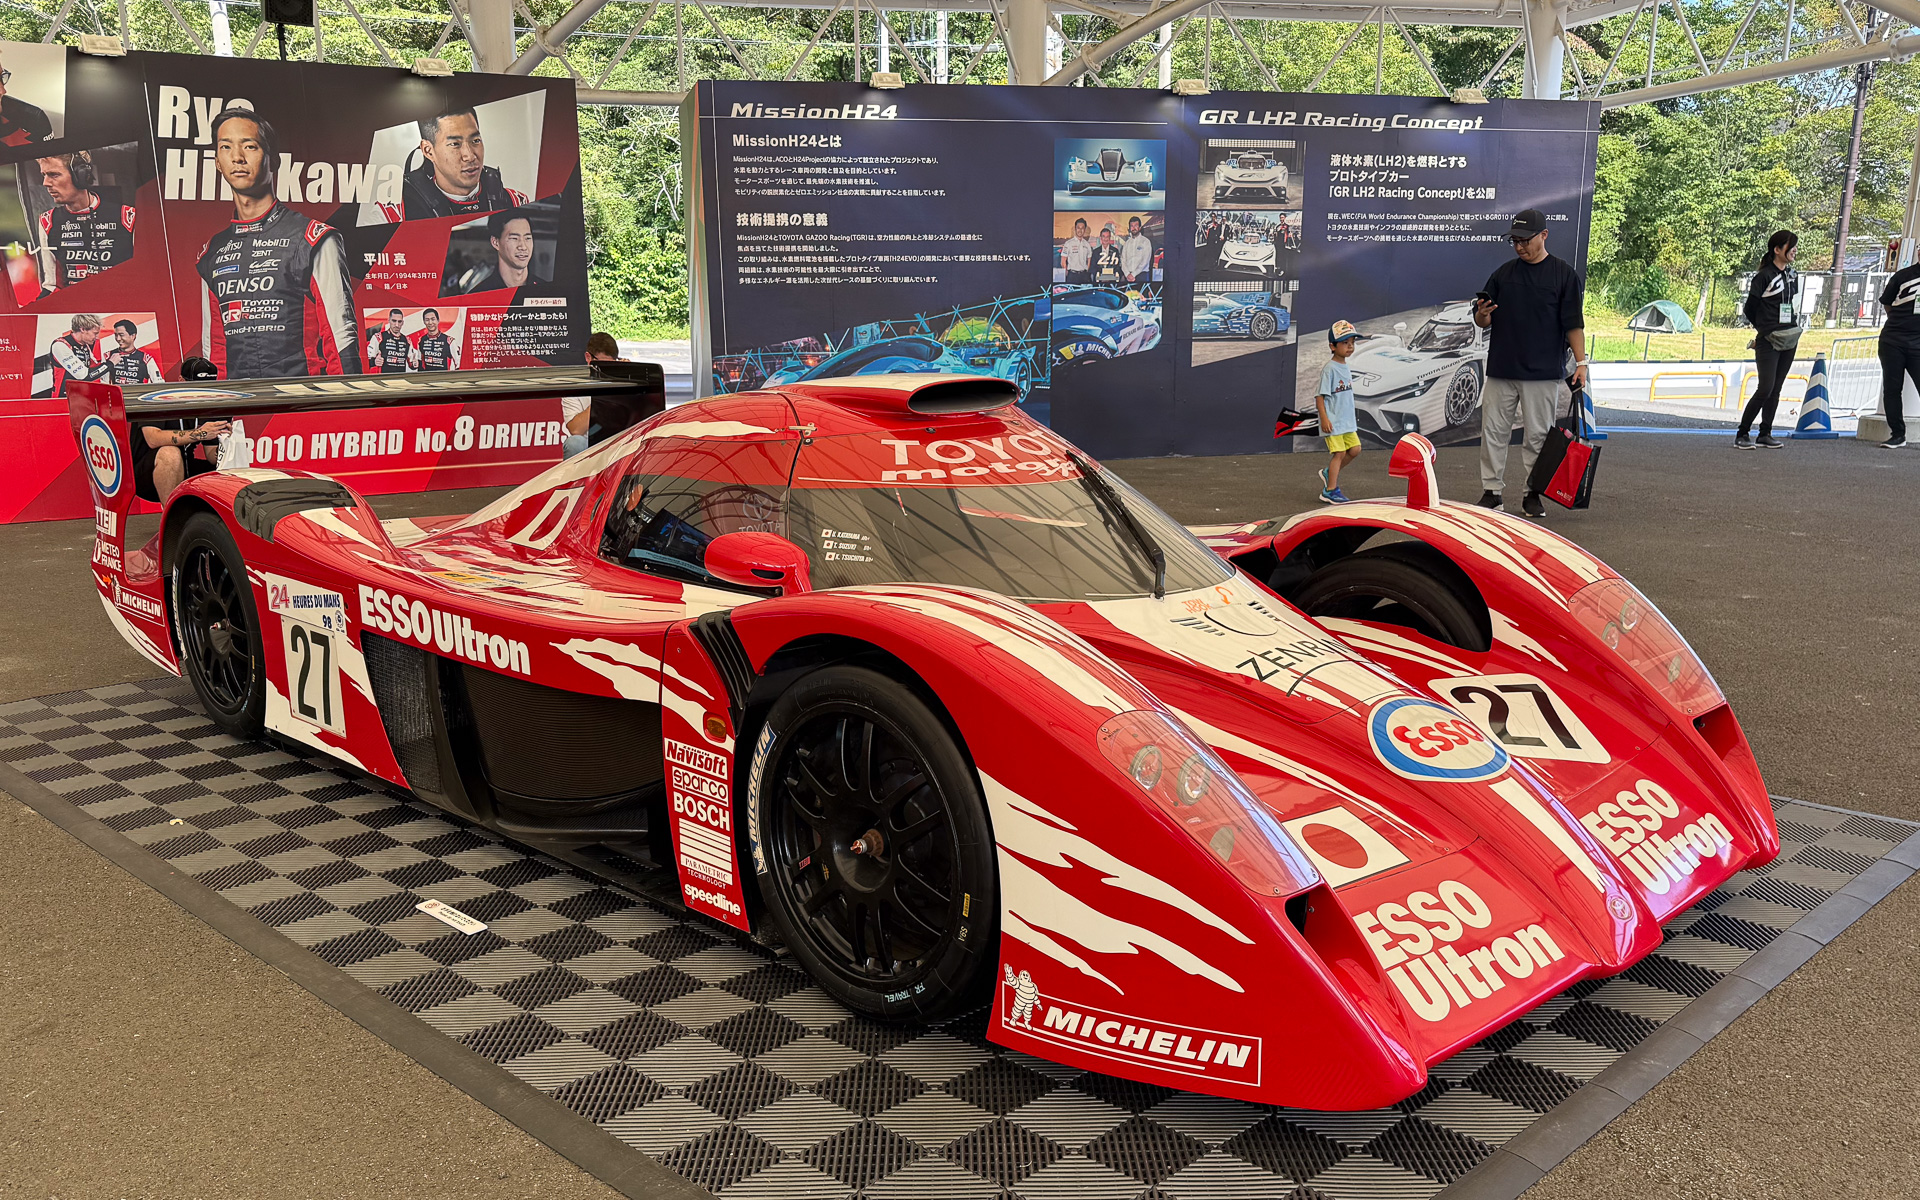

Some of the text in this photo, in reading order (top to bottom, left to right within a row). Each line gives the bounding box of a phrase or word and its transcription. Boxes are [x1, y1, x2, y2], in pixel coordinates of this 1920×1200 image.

[157, 85, 255, 145] Ry
[731, 103, 897, 120] MissionH24
[1199, 110, 1483, 134] GR LH2 Racing Concept
[732, 134, 842, 148] MissionH24とは
[1330, 153, 1467, 168] 液体水素(LH2)を燃料とする
[164, 148, 404, 203] Hikawa
[1329, 170, 1410, 183] プロトタイプカー
[1329, 186, 1496, 200] 「GR LH2 Racing Concept」を公開
[736, 212, 828, 227] 技術提携の意義
[252, 239, 279, 247] Mobil
[736, 233, 803, 242] MissionH24とTOYOTA
[805, 233, 828, 241] GAZOO
[66, 250, 111, 262] DENSO
[364, 252, 407, 266] 平川 亮
[217, 276, 274, 297] DENSO
[242, 299, 284, 307] TOYOTA
[242, 312, 277, 320] Racing
[1086, 342, 1113, 359] MICHEL
[243, 435, 303, 464] R010
[311, 429, 404, 459] HYBRID
[479, 420, 569, 450] DRIVERS
[881, 430, 1069, 465] TOYOT
[122, 591, 161, 617] MICHELIN
[270, 583, 341, 610] 24 HEURES DU MANS
[322, 614, 333, 629] 98
[290, 624, 333, 727] 27
[1450, 683, 1582, 750] 27
[666, 740, 727, 777] Navisoft
[673, 769, 727, 800] sparco
[749, 725, 772, 844] MICHELIN
[673, 791, 731, 832] BOSCH
[1578, 778, 1680, 857] ESSO
[1618, 811, 1735, 896] Ultron
[685, 857, 729, 882] PARAMETRIC
[687, 868, 727, 890] TECHNOLOGY
[684, 883, 741, 916] speedline
[1353, 879, 1493, 961] ESSO
[1386, 922, 1566, 1023] Ultron
[1043, 1006, 1252, 1068] MICHELIN
